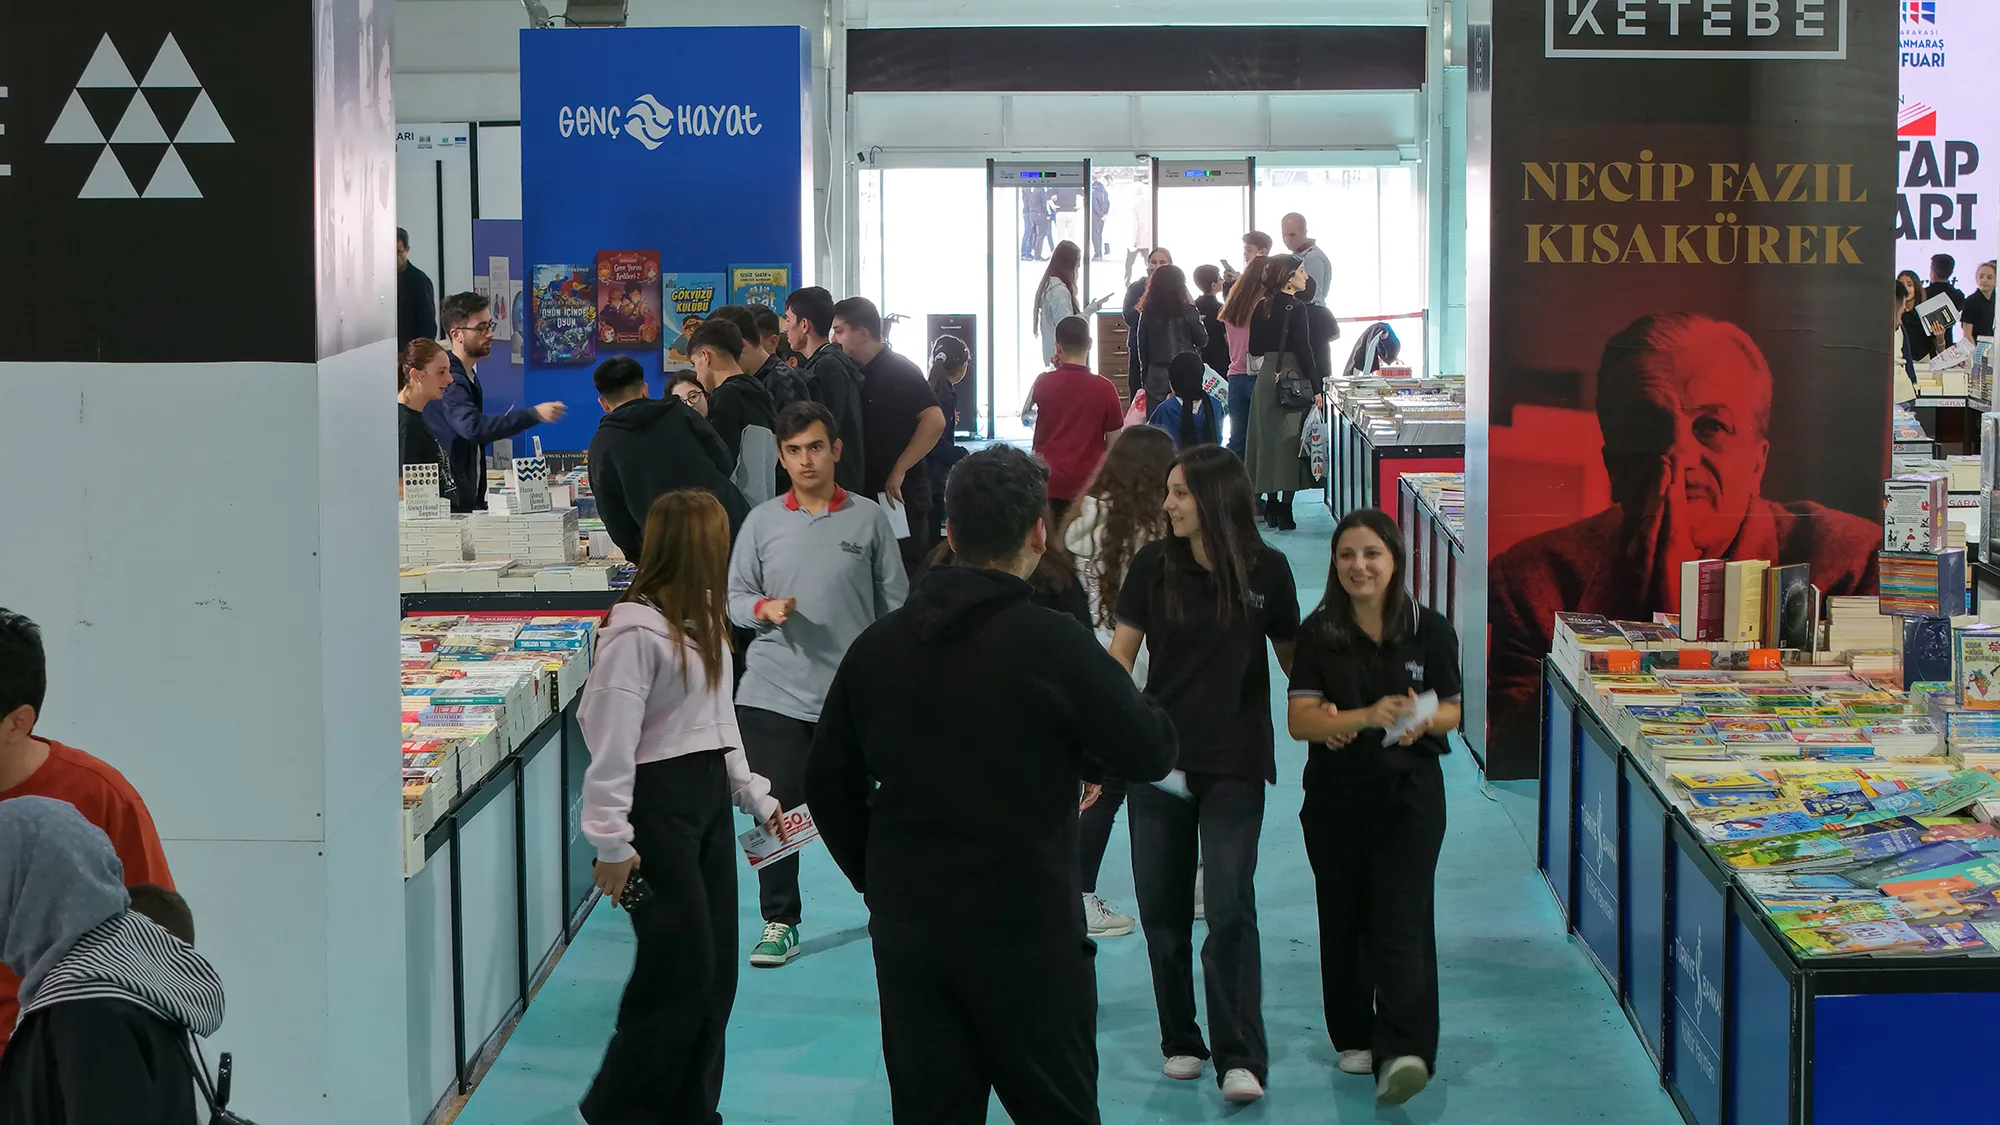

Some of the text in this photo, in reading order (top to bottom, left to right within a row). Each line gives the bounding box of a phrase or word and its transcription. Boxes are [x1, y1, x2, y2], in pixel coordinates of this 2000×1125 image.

[1568, 0, 1824, 36] KETEBE
[1901, 52, 1945, 68] FUARI
[1521, 149, 1868, 203] NECİP FAZIL
[1524, 212, 1865, 265] KISAKÜREK
[671, 285, 713, 301] GÖKYÜZÜ
[676, 299, 710, 313] KULÜBÜ
